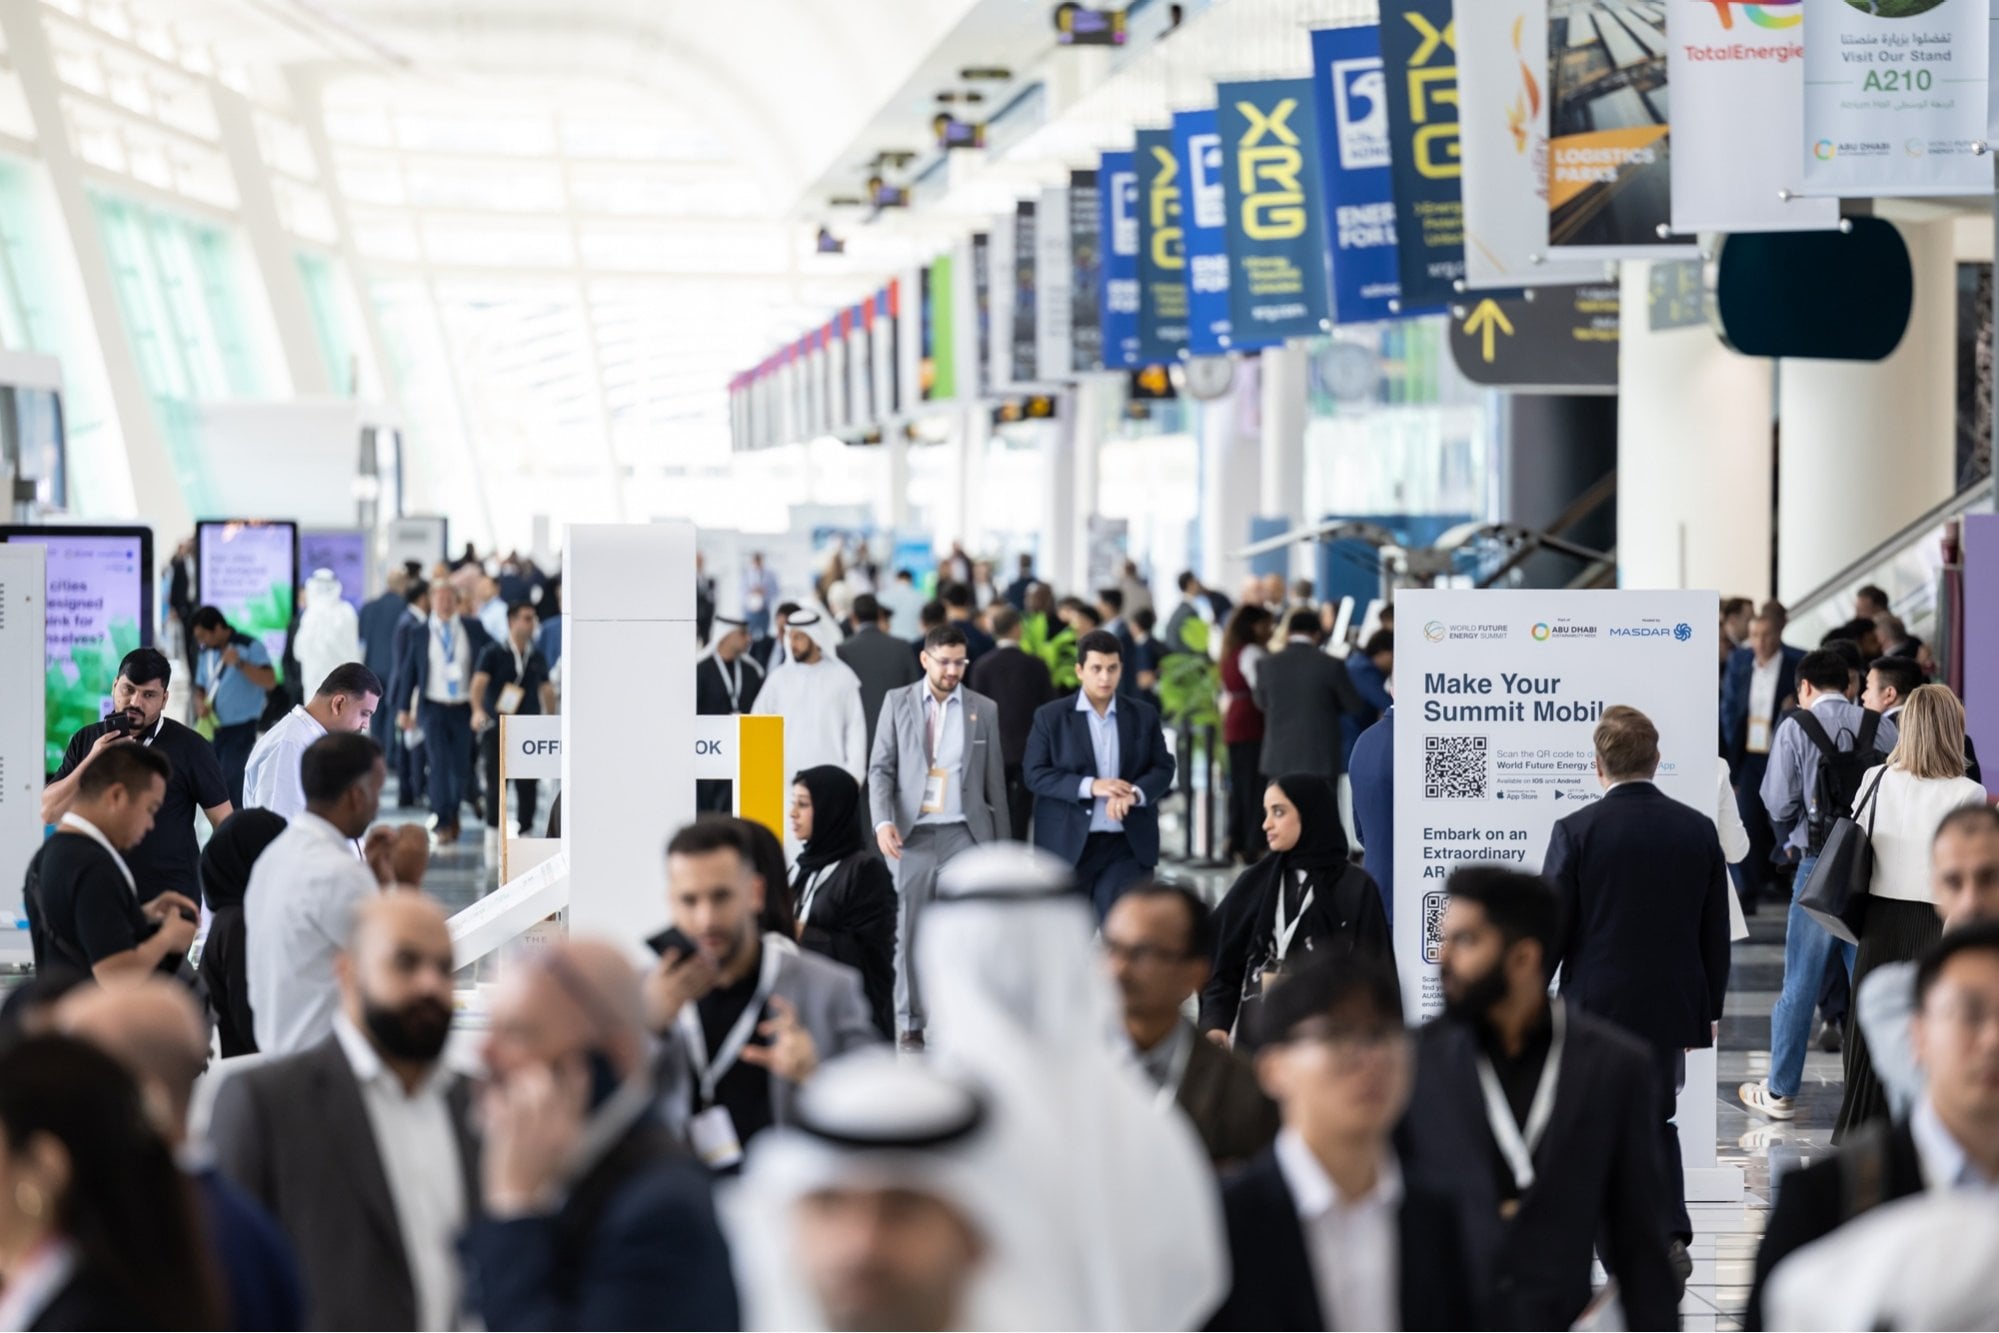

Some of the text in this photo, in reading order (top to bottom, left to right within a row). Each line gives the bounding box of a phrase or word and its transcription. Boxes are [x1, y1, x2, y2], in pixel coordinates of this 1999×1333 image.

[1684, 43, 1804, 63] TotalEnergie
[1841, 50, 1952, 62] Visit Our Stand
[1862, 69, 1932, 92] A210
[1555, 147, 1656, 164] LOGISTICS
[1235, 98, 1306, 241] XRG
[1555, 165, 1618, 183] PARKS
[50, 578, 87, 592] cities
[47, 598, 104, 611] esigned
[74, 614, 93, 626] for
[1609, 628, 1670, 637] MASDAR
[1424, 672, 1561, 694] Make Your
[1423, 700, 1603, 722] Summit Mobil
[1496, 750, 1519, 758] Scan
[1521, 750, 1534, 758] the
[1536, 750, 1551, 759] QR
[1553, 750, 1574, 758] code
[1576, 750, 1585, 758] to
[1496, 761, 1523, 769] World
[1525, 761, 1554, 769] Future
[1556, 761, 1588, 771] Energy
[1423, 828, 1527, 840] Embark on an
[1423, 846, 1526, 862] Extraordinary
[1423, 866, 1445, 878] AR
